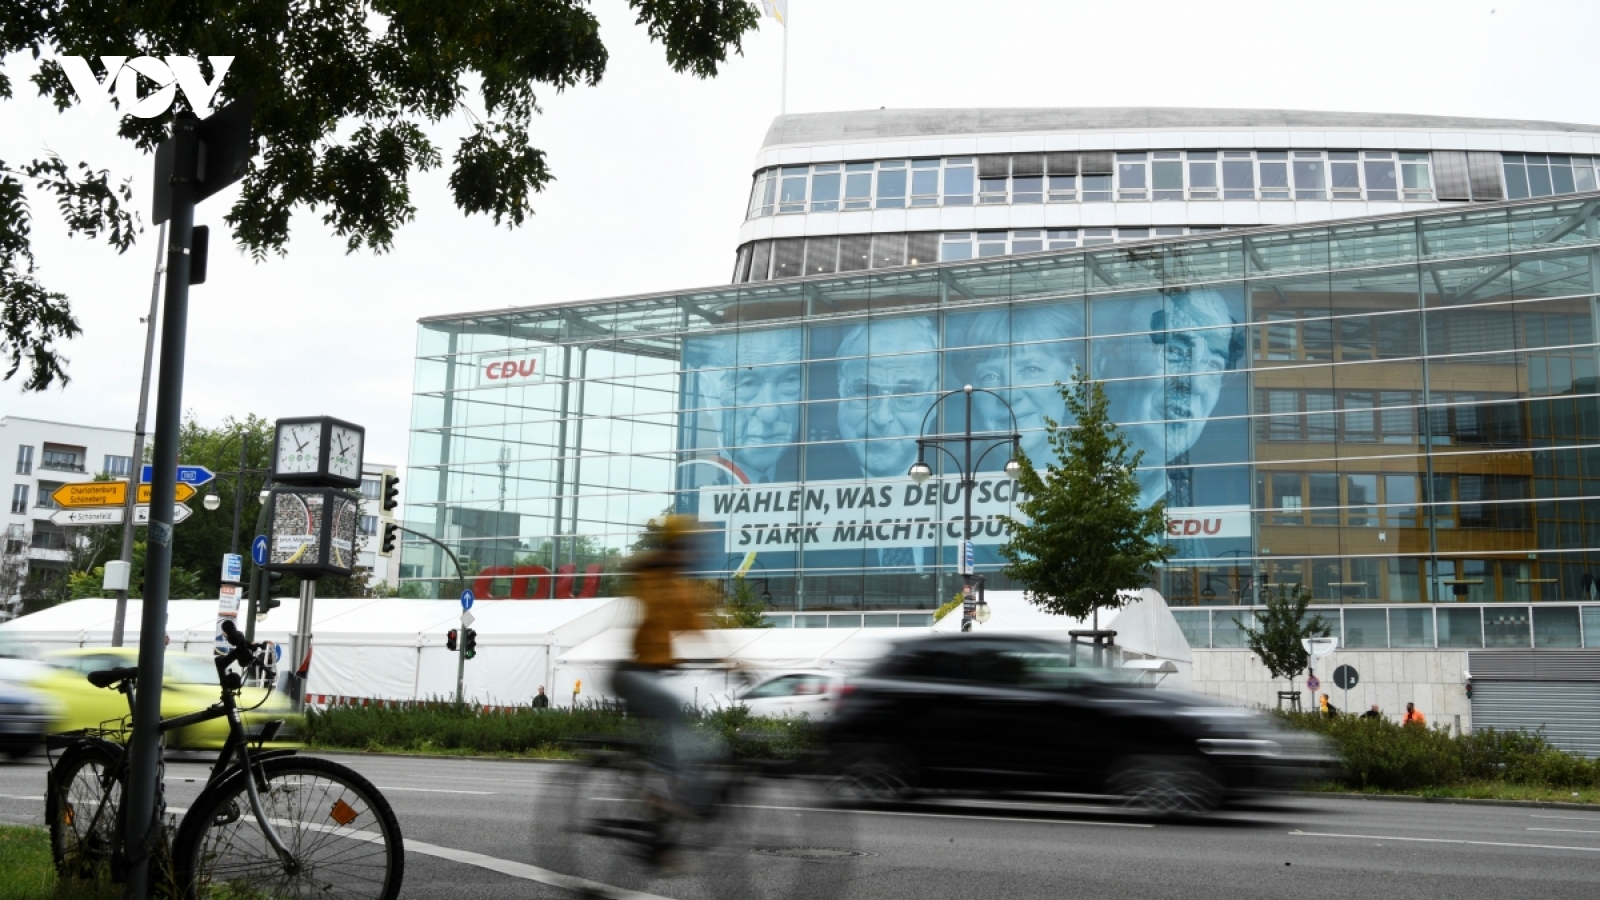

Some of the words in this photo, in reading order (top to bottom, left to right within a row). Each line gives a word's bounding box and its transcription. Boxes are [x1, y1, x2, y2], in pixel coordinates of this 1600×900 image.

[485, 358, 537, 380] CDU
[70, 486, 117, 495] Charlottenburg
[70, 495, 107, 504] Schöneberg
[713, 487, 830, 515] WÄHLEN,
[836, 484, 893, 510] WAS
[77, 512, 112, 521] Schönefeld
[738, 520, 823, 546] STARK
[832, 517, 937, 543] MACHT:
[1167, 518, 1222, 536] CDU
[473, 563, 601, 600] CDU
